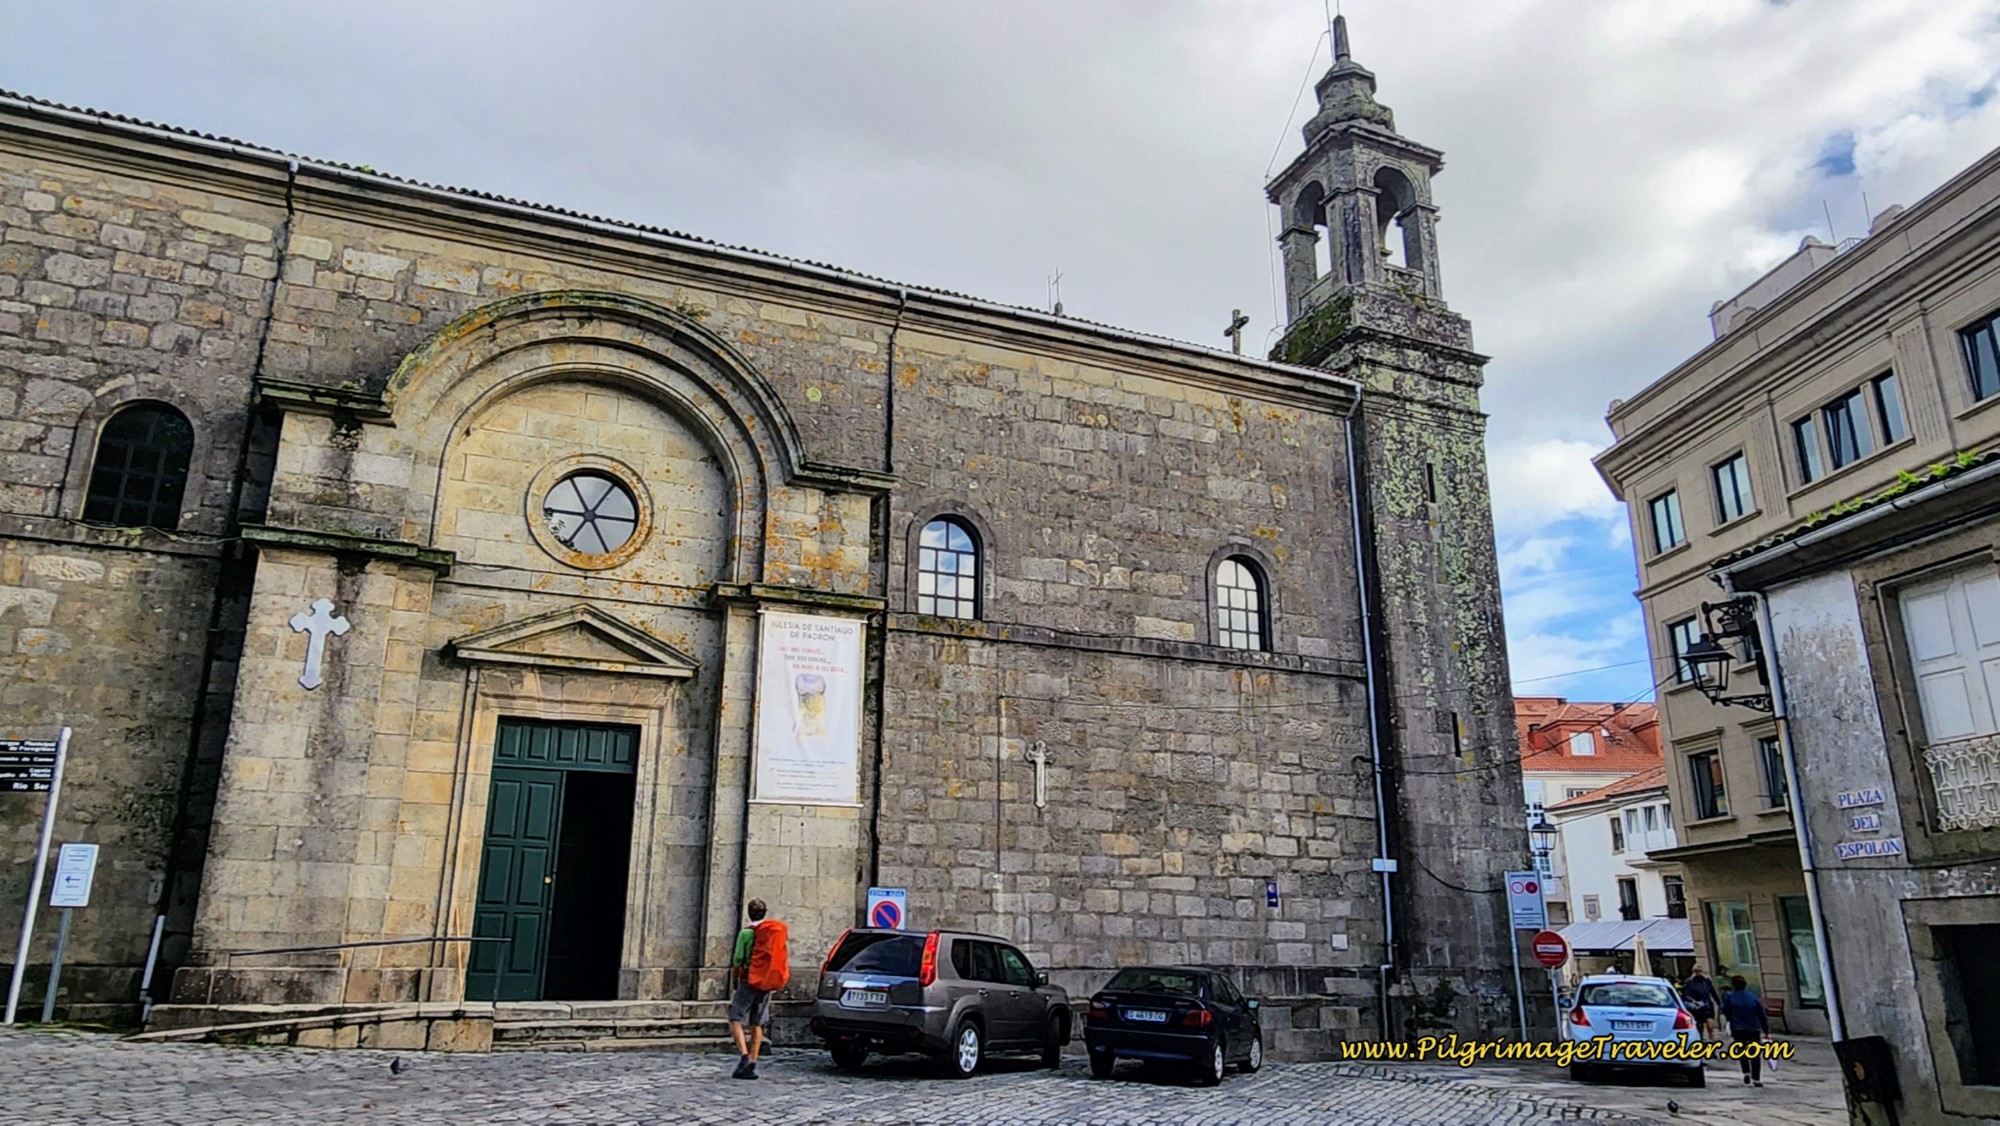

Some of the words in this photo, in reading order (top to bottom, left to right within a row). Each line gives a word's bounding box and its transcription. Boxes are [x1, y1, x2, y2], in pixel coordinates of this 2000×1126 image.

[771, 621, 800, 629] IGLESIA
[802, 623, 813, 631] DE
[815, 624, 853, 635] SANTIAGO
[33, 782, 49, 790] Sar
[1839, 790, 1882, 807] PLAZA
[1852, 816, 1878, 830] DEL
